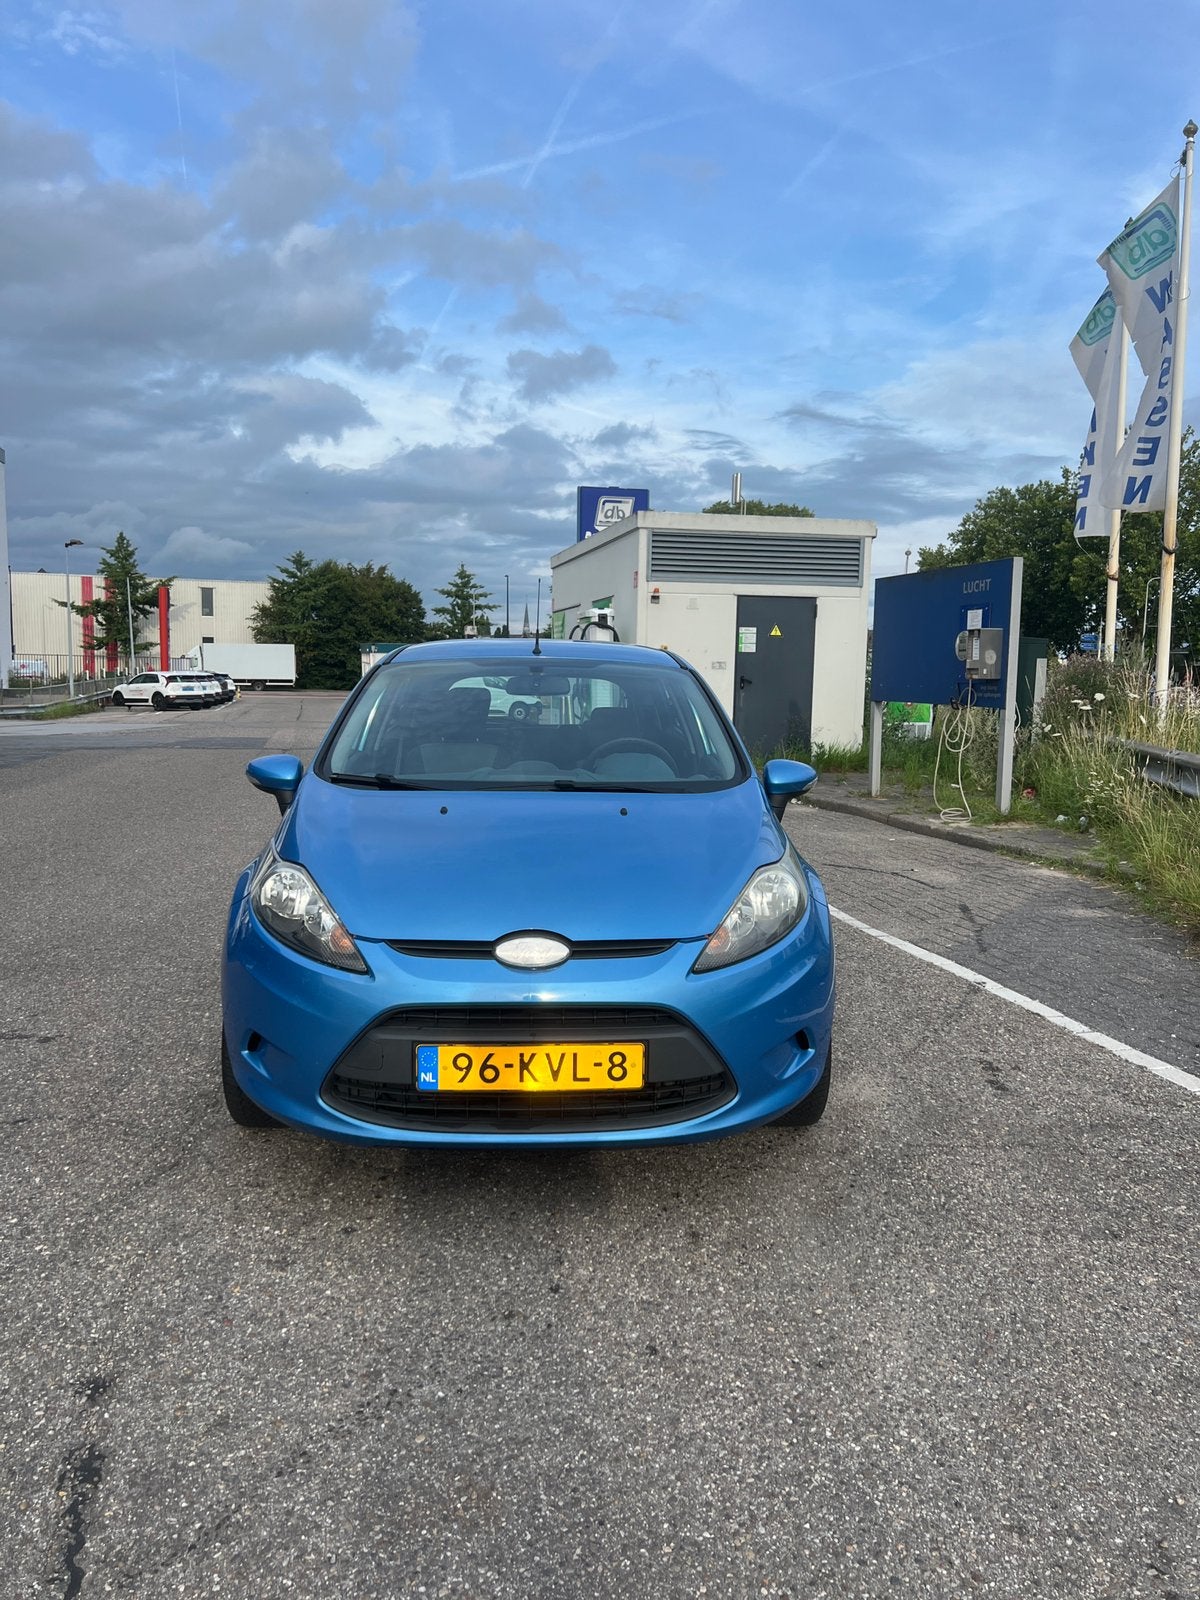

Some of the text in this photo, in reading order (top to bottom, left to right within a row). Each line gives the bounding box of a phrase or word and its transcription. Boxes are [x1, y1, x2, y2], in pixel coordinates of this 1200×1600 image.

[603, 505, 626, 520] db
[963, 578, 992, 594] LUCHT
[452, 1051, 628, 1084] 96-KVL-8
[421, 1072, 436, 1083] NL
